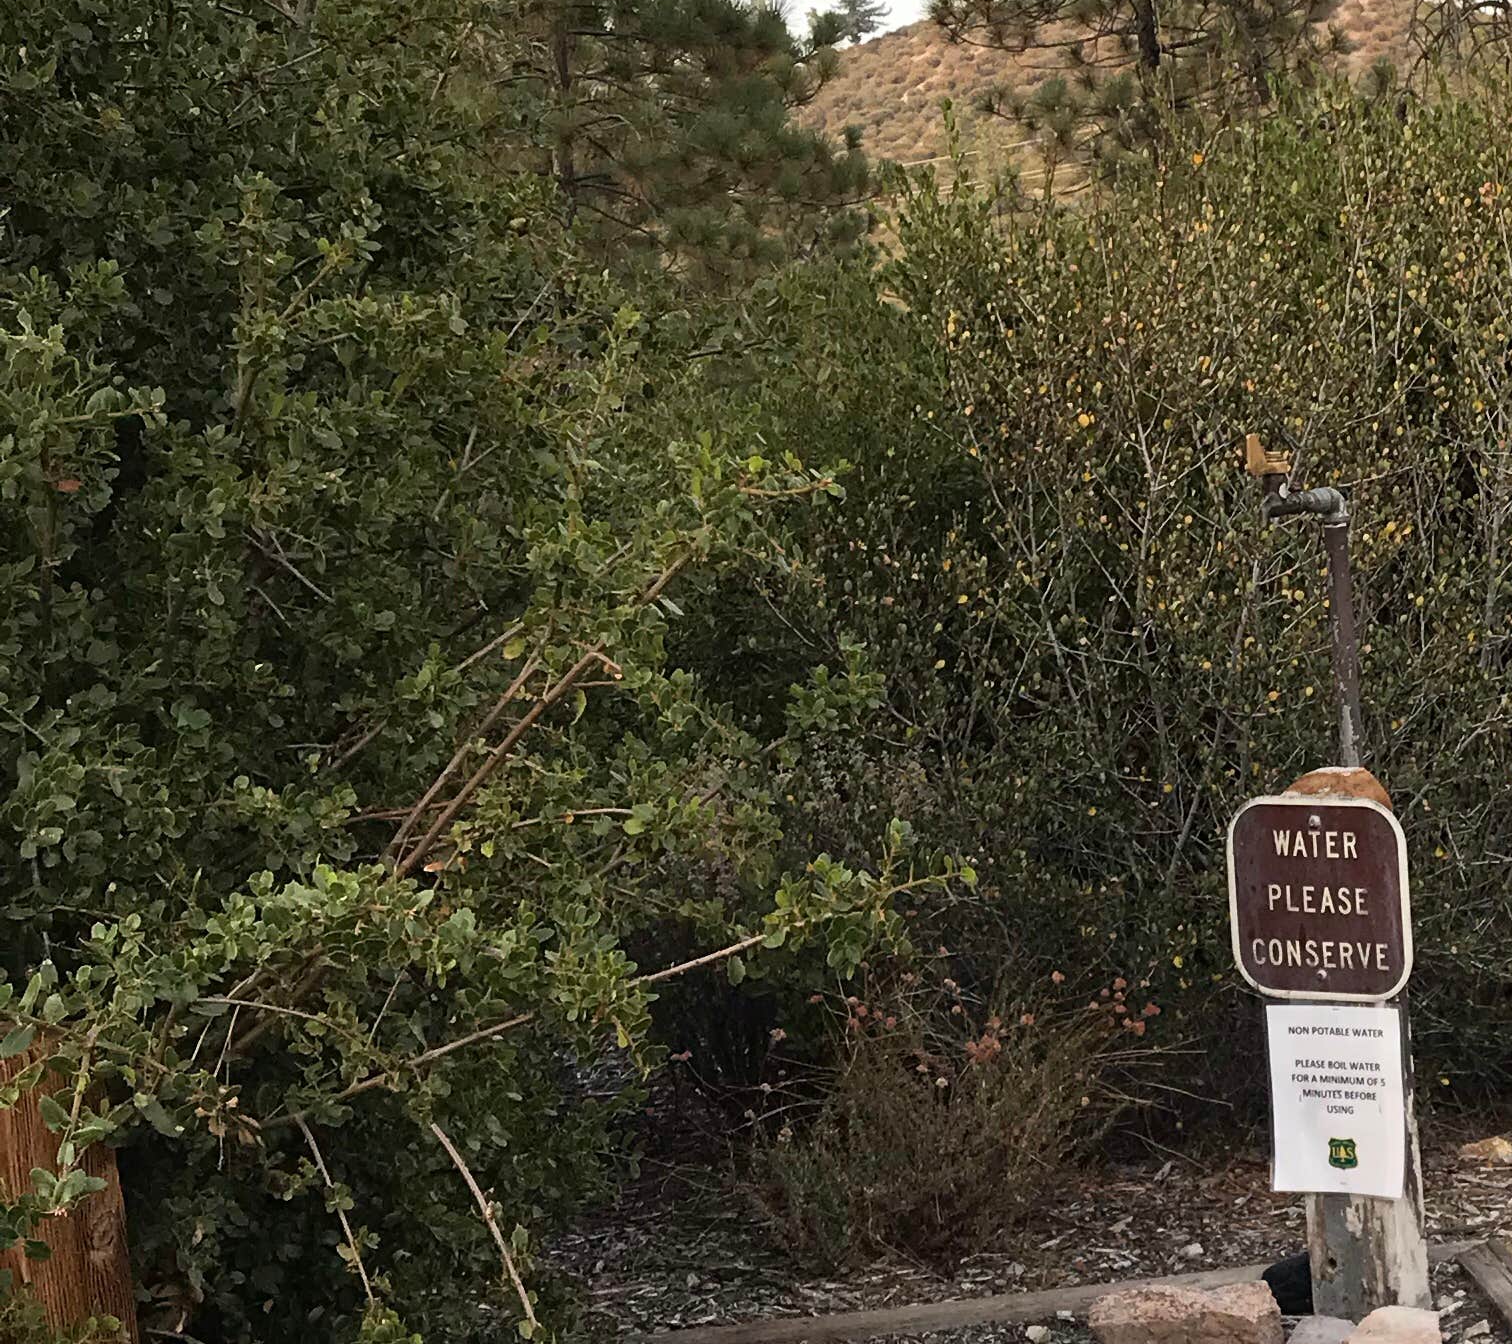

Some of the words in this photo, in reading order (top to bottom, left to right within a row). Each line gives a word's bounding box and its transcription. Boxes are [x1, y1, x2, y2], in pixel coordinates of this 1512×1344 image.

[1273, 830, 1358, 858] WATER
[1268, 884, 1369, 915] PLEASE
[1252, 938, 1390, 971] CONSERVE
[1288, 1026, 1310, 1035] NON
[1311, 1027, 1350, 1037] POTABLE
[1352, 1028, 1383, 1037] WATER
[1295, 1059, 1325, 1069] PLEASE
[1327, 1061, 1346, 1070] BOIL
[1349, 1061, 1381, 1071] WATER
[1291, 1074, 1309, 1083] FOR
[1311, 1074, 1318, 1083] A
[1319, 1075, 1365, 1086] MINIMUM
[1366, 1077, 1378, 1086] OF
[1380, 1078, 1386, 1087] 5
[1302, 1089, 1342, 1099] MINUTES
[1344, 1091, 1377, 1101] BEFORE
[1326, 1105, 1354, 1115] USING
